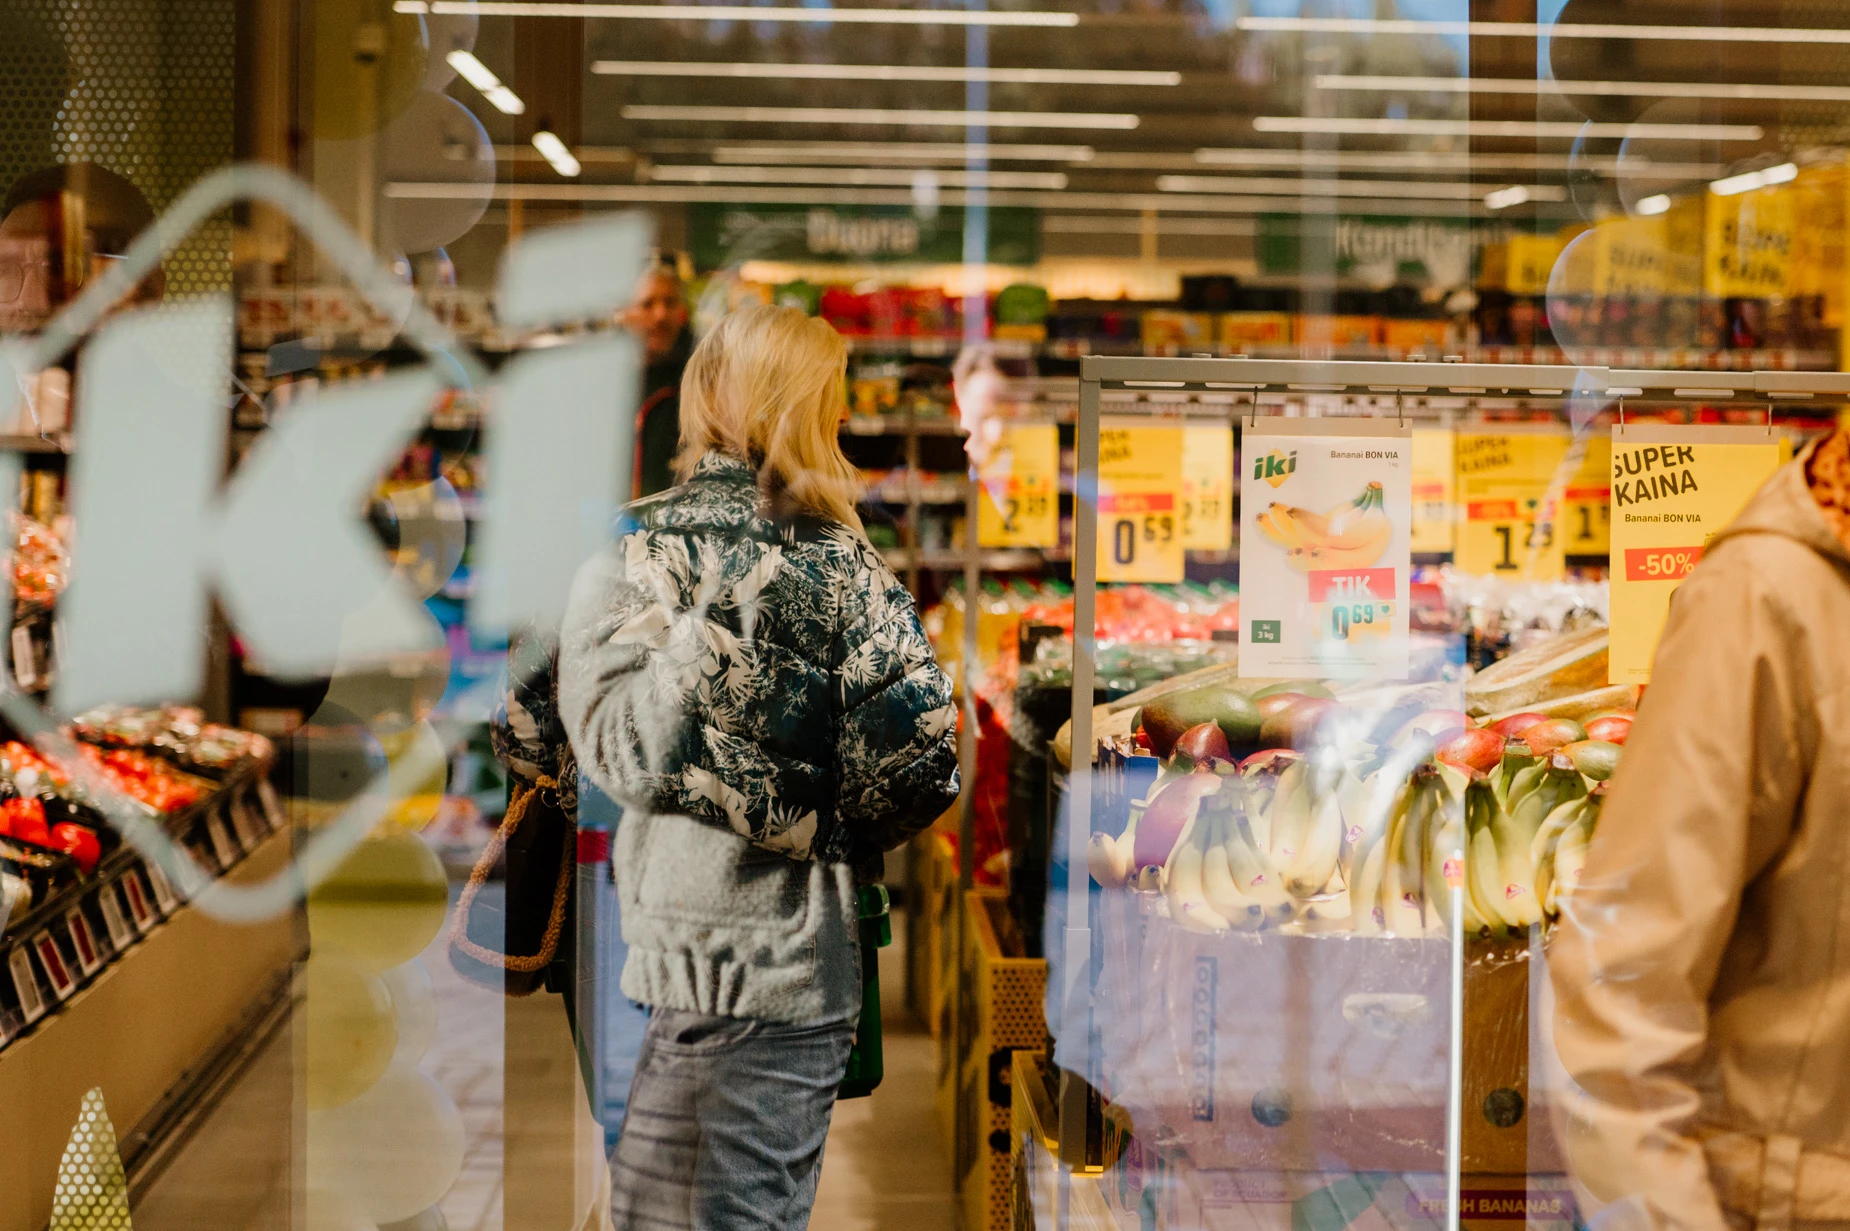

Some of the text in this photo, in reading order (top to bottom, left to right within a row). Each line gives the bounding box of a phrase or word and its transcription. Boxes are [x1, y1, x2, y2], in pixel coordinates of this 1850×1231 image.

[0, 206, 656, 716] ki
[1253, 450, 1298, 481] iki
[1330, 450, 1399, 459] Bananai BON VIA
[1614, 469, 1699, 507] KAINA
[1579, 506, 1594, 540] 1
[1625, 513, 1702, 523] Bananai BON VIA
[1114, 519, 1135, 565] 0
[1495, 527, 1517, 570] 1
[1638, 553, 1695, 576] -50%
[1332, 575, 1371, 597] TIK
[1257, 631, 1274, 641] 3 kg
[1332, 604, 1374, 641] 0 69
[1419, 1199, 1561, 1214] FREH BANANAS
